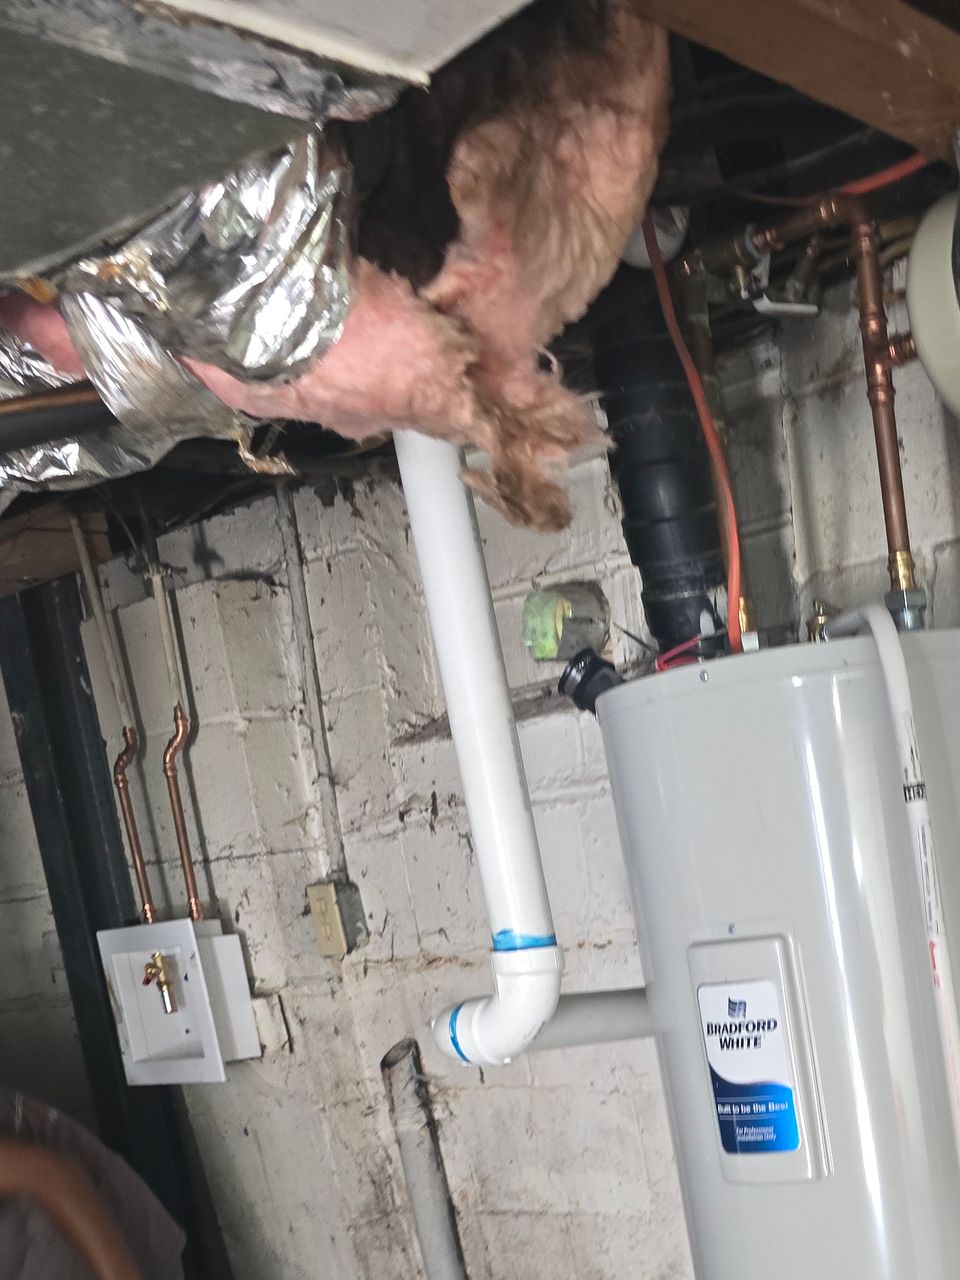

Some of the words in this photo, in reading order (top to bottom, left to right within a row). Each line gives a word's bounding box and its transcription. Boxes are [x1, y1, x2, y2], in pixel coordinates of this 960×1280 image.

[707, 1018, 777, 1036] BRADFORD
[719, 1035, 762, 1051] WHITE
[741, 1103, 751, 1114] be
[753, 1102, 766, 1113] the
